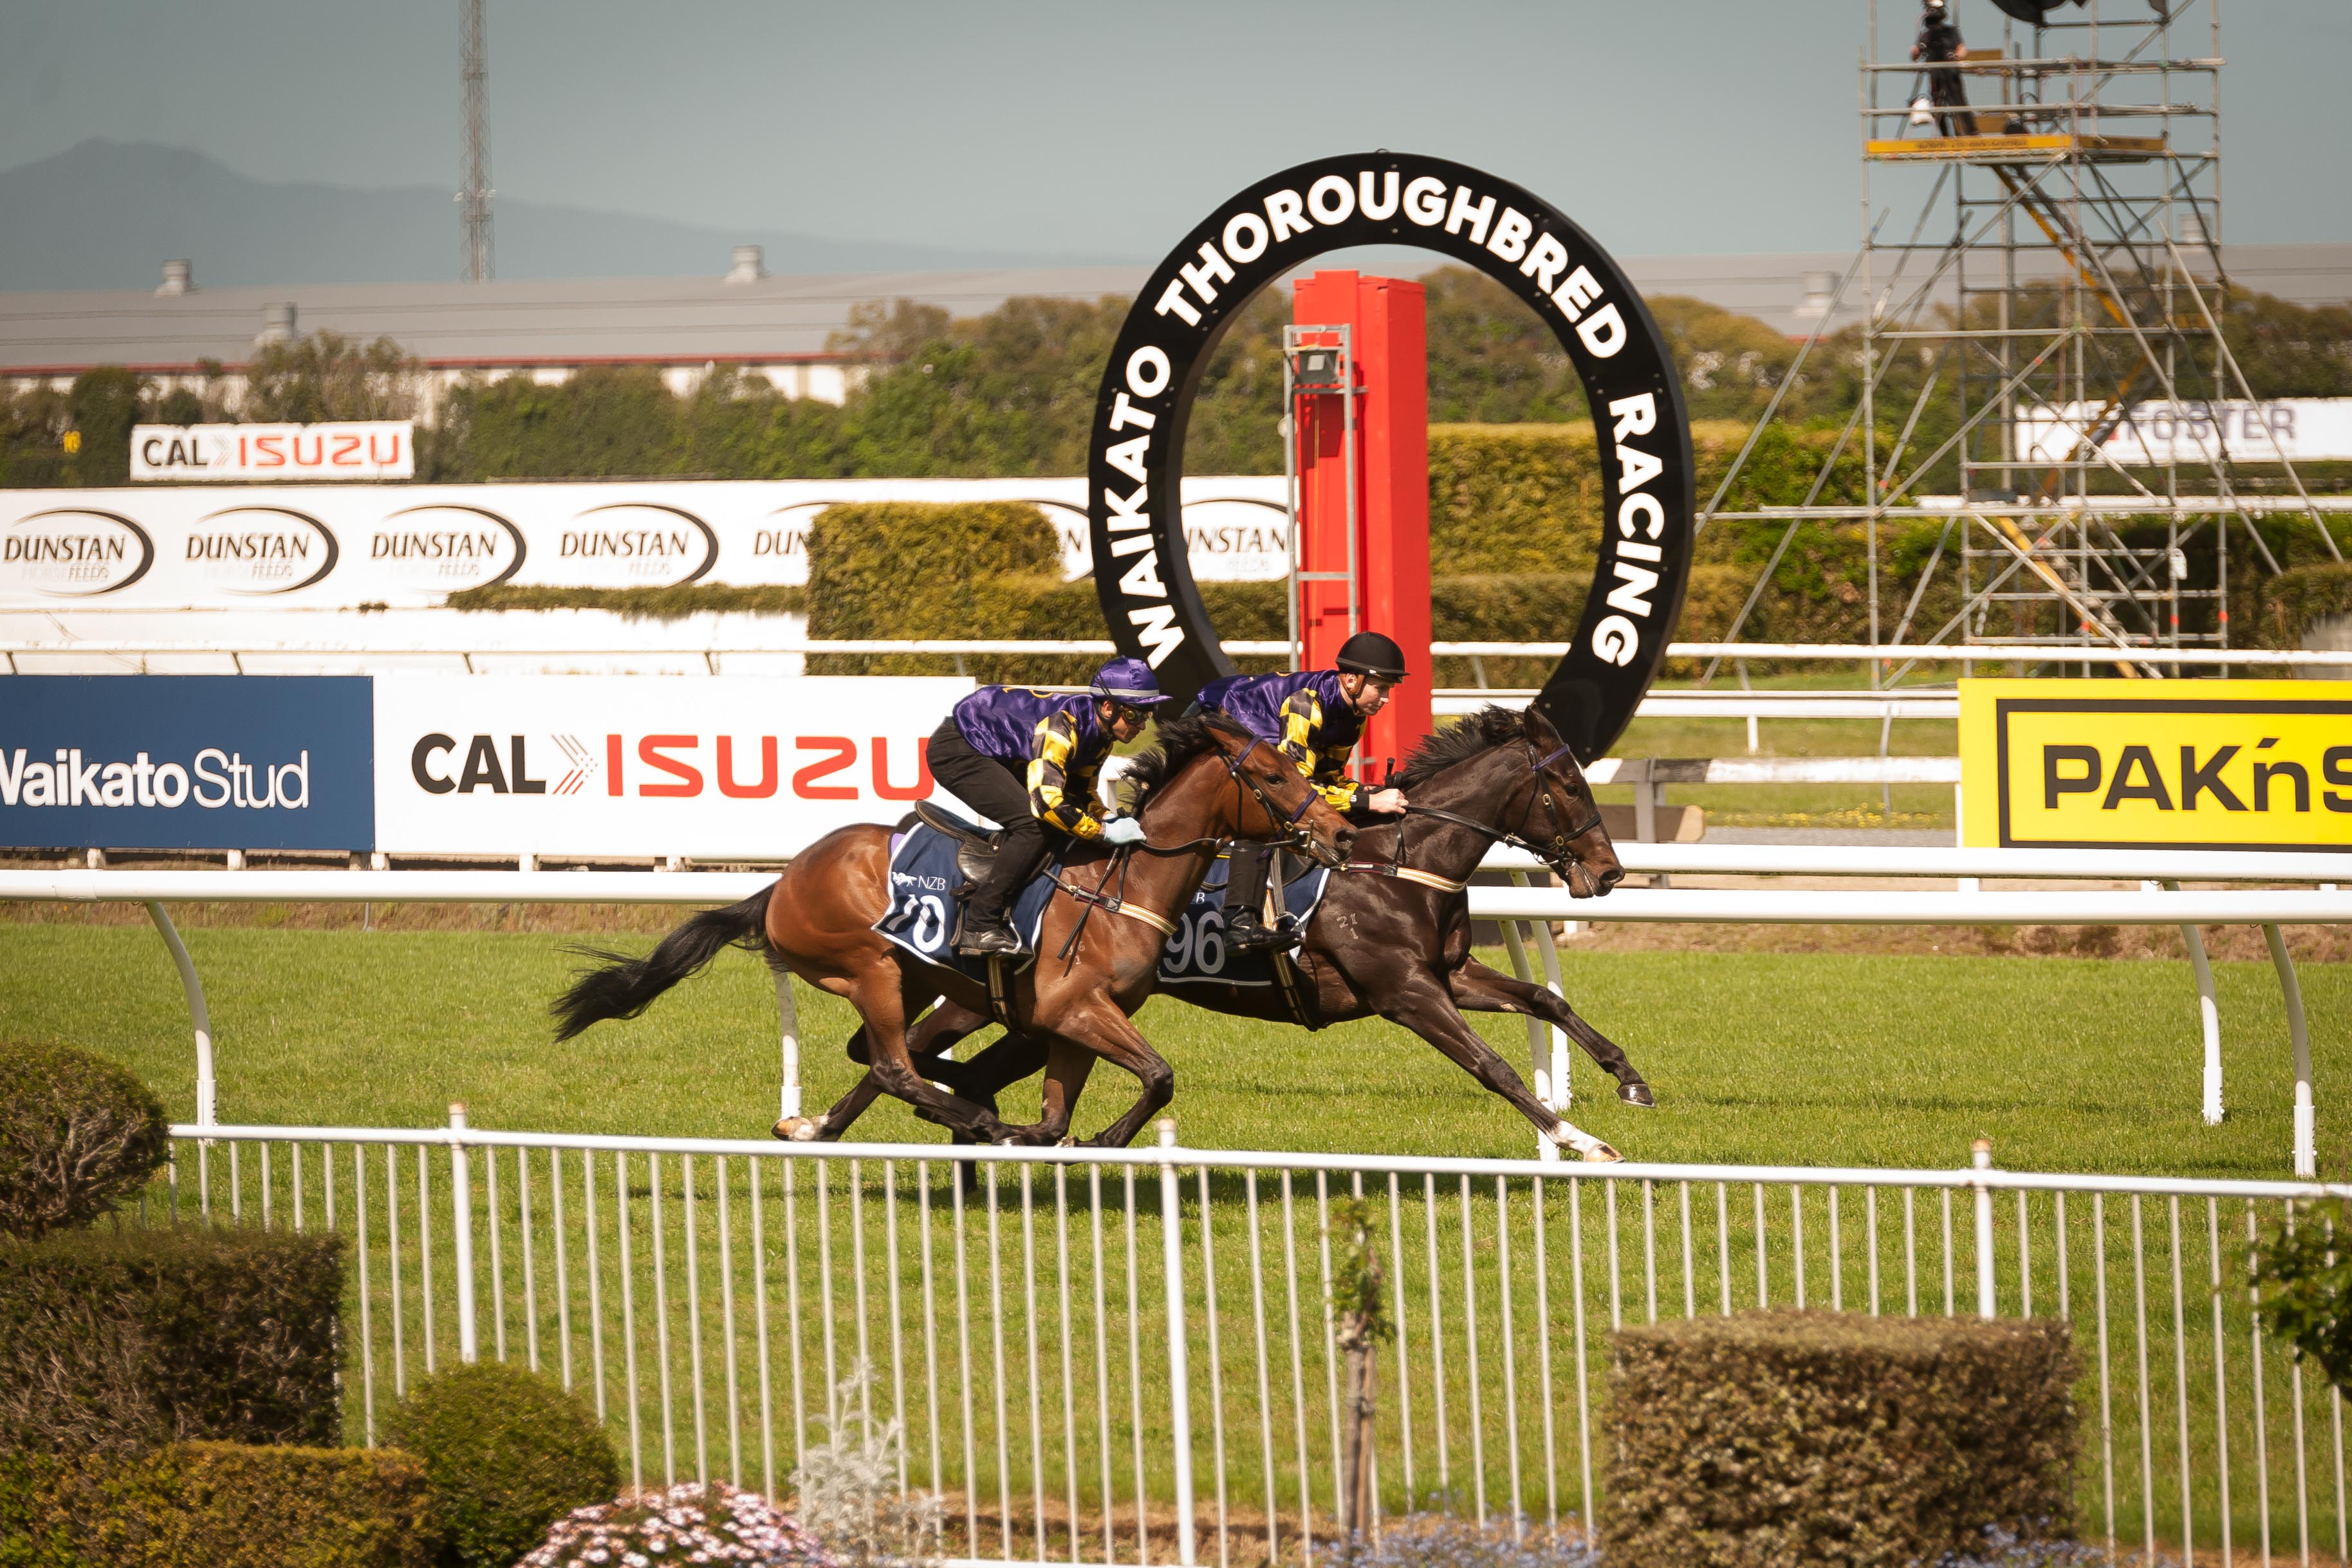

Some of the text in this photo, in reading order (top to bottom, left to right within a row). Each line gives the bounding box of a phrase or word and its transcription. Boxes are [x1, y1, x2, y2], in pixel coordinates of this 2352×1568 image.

[1105, 171, 1664, 669] WAIKATO THOROUGHBRED RACING
[142, 435, 399, 467] CAL ISUZU
[3, 535, 125, 562] DUNSTAN
[185, 533, 309, 560] DUNSTAN
[371, 531, 497, 558] DUNSTAN
[560, 530, 688, 557] DUNSTAN
[1188, 528, 1287, 553] NSTAN
[68, 562, 109, 582] FEEDS
[194, 748, 308, 809] Stud
[411, 733, 934, 800] CAL ISUZU
[918, 875, 946, 891] NZB
[1163, 911, 1225, 973] 96
